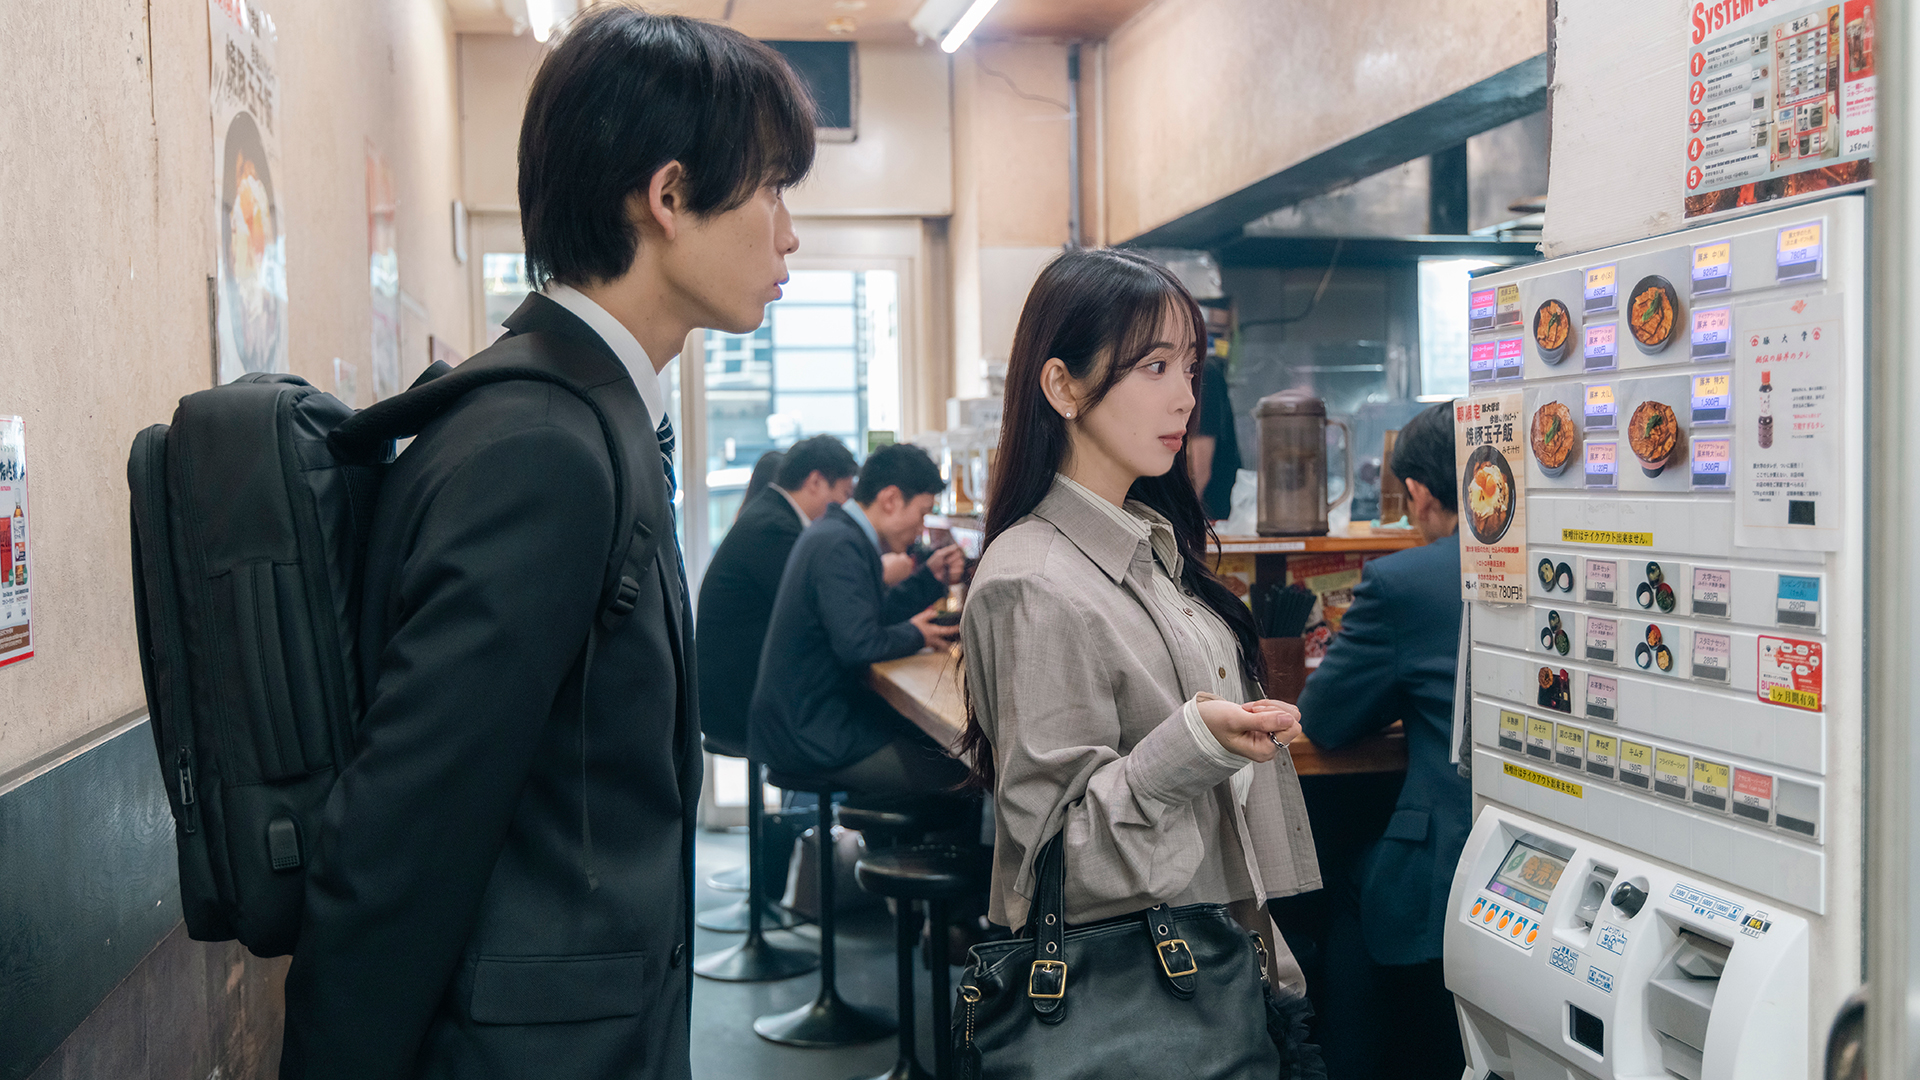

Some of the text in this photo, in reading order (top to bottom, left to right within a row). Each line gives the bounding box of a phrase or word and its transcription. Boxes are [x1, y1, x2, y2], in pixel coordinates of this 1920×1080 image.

[1692, 0, 1754, 45] SYSTEM
[1694, 56, 1699, 73] 1
[1693, 84, 1700, 102] 2
[1692, 112, 1699, 130] 3
[1846, 125, 1874, 138] Coca-Cola
[1691, 141, 1698, 158] 4
[1690, 170, 1697, 187] 5
[1703, 266, 1718, 277] 920円
[1703, 332, 1718, 341] 920円
[1465, 423, 1513, 446] 焼豚玉子飯
[1499, 585, 1519, 600] 780円
[1772, 689, 1816, 708] 1ヶ月間有効
[1629, 748, 1643, 759] キムチ
